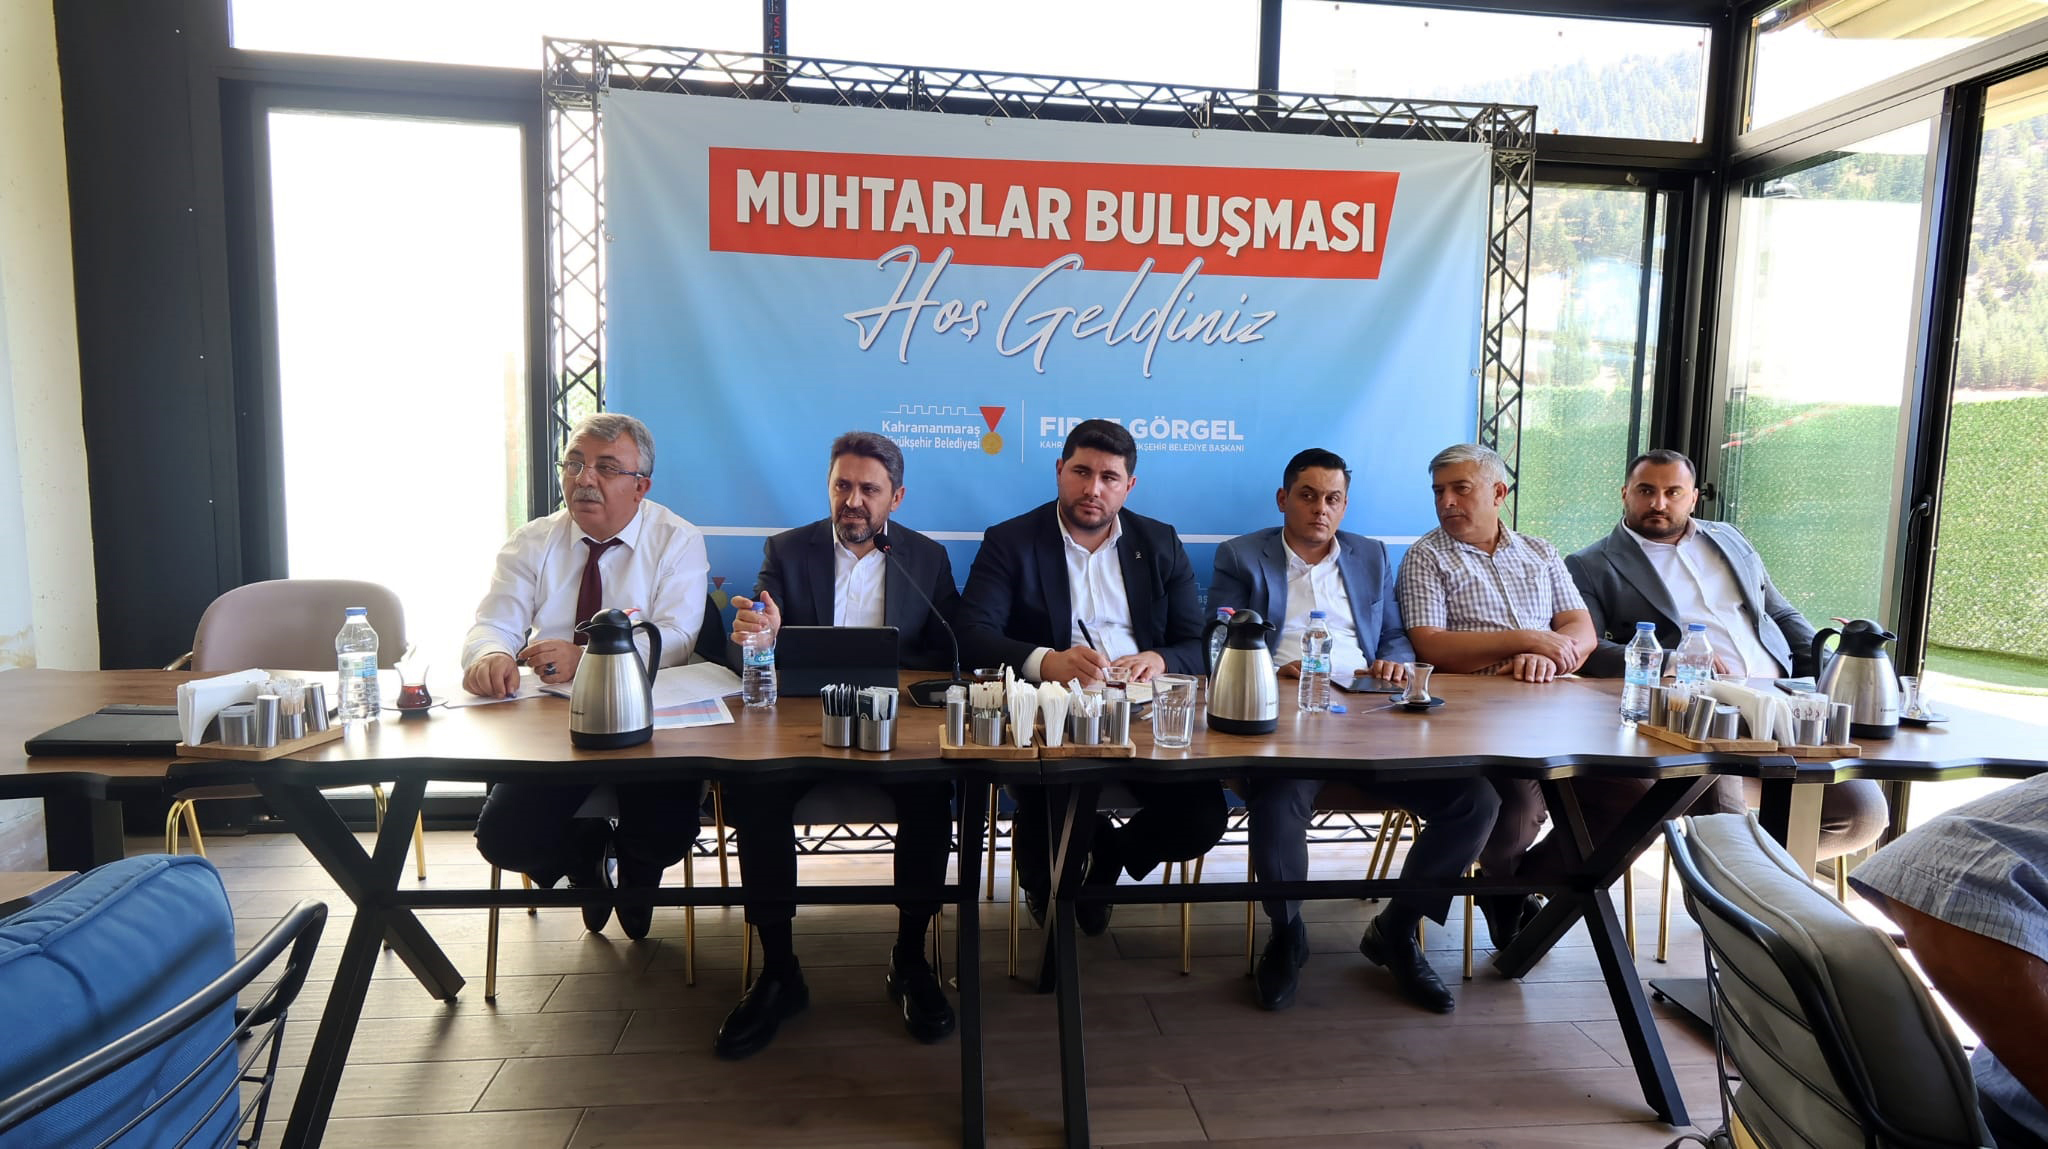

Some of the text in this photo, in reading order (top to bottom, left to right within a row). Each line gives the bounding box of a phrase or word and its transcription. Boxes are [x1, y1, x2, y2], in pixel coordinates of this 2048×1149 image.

[736, 168, 1376, 257] MUHTARLAR BULUŞMASI
[844, 246, 1277, 378] Hoş Geldiniz
[882, 420, 981, 437] Kahramanmaraş
[1129, 416, 1244, 440] GÖRGEL
[934, 437, 980, 452] Belediyesi
